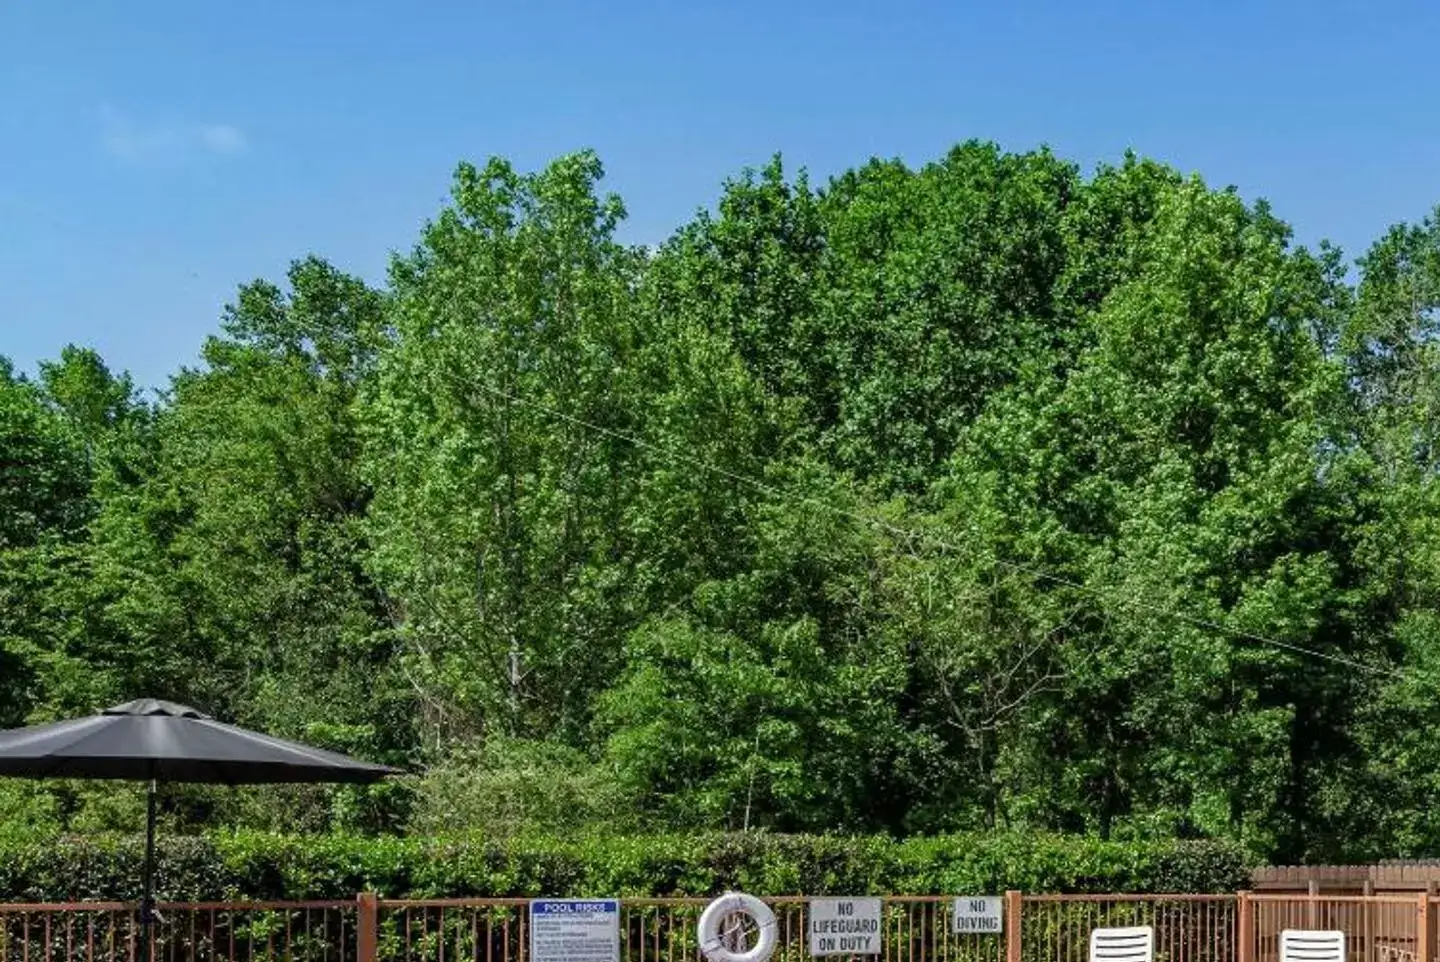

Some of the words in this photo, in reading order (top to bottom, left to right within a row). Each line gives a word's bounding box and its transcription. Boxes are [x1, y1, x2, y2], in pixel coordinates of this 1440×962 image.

[544, 903, 573, 913] POOL
[838, 902, 853, 916] NO
[970, 900, 985, 912] NO
[813, 918, 878, 933] LIFEGUARD
[957, 916, 998, 929] DIVING
[819, 938, 835, 950] ON
[841, 936, 872, 950] DUTY
